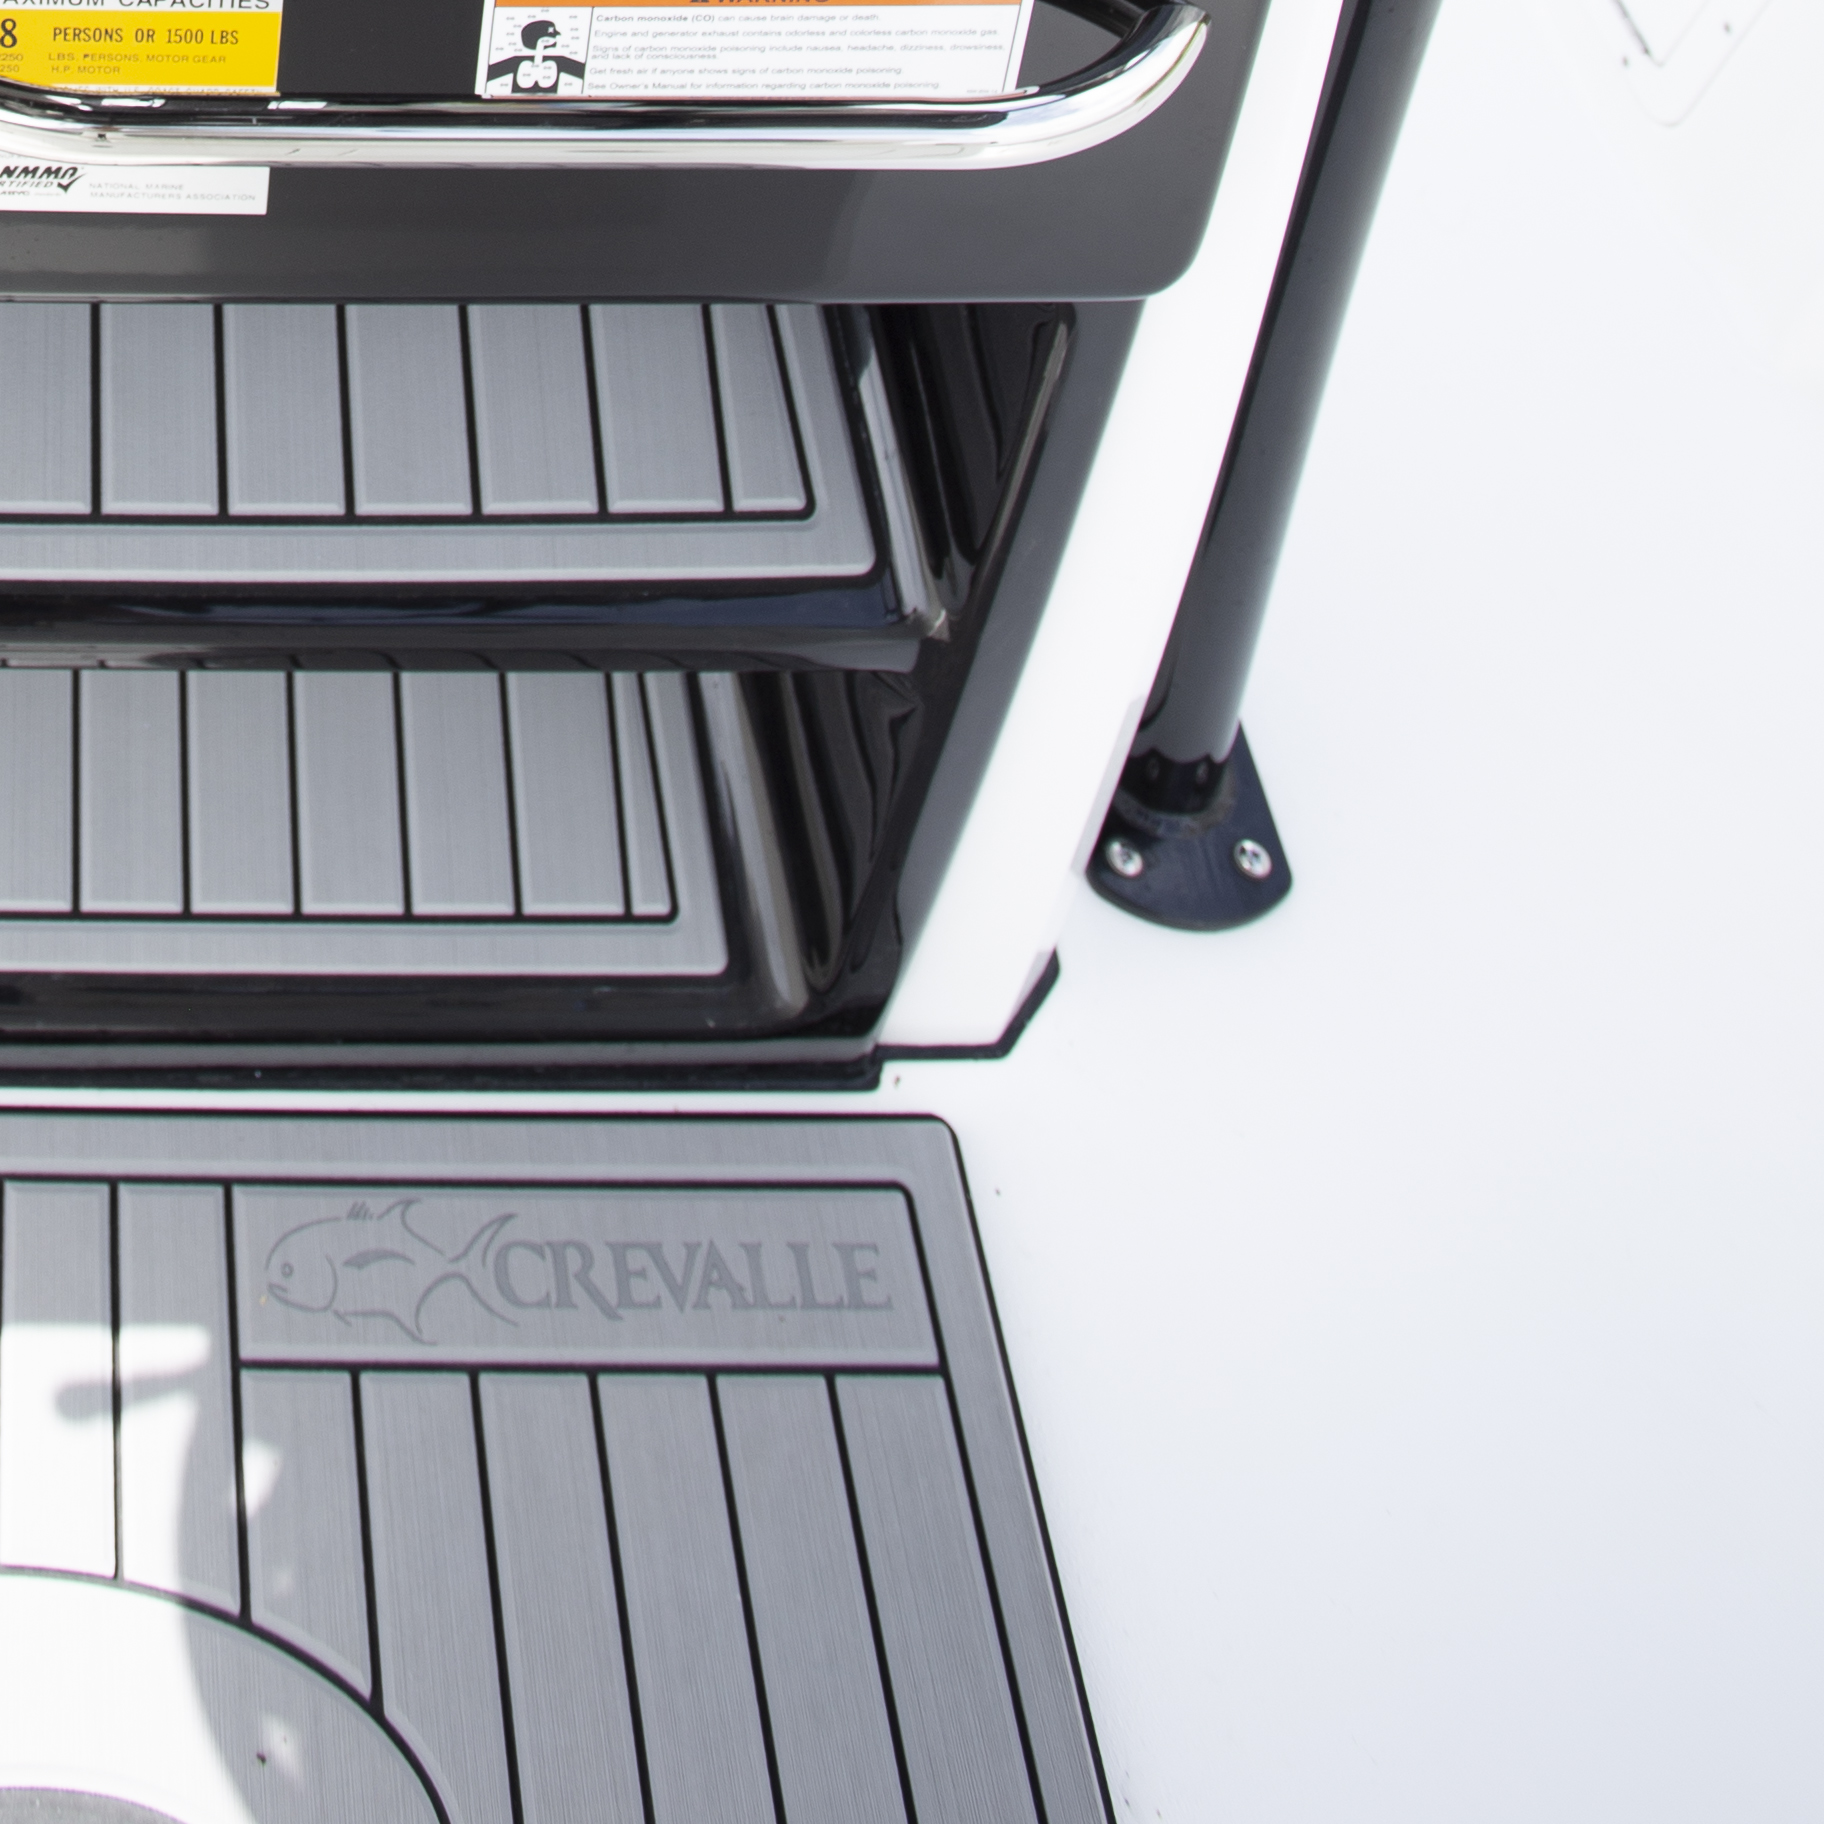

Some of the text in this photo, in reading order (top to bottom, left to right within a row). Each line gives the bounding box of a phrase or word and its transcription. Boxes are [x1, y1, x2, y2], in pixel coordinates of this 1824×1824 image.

[691, 14, 715, 23] (CO)
[797, 14, 836, 23] damage
[0, 18, 18, 48] 8
[53, 27, 239, 45] PERSONS OR 1500 LBS
[594, 30, 628, 38] Engine
[652, 30, 698, 38] generator
[592, 45, 619, 53] Signs
[720, 45, 766, 53] poisoning
[146, 54, 189, 63] MOTOR
[192, 55, 227, 63] GEAR
[0, 65, 20, 73] 250
[77, 66, 121, 74] MOTOR
[761, 82, 806, 90] regarding
[89, 182, 184, 191] NATIONAL MARINE
[90, 192, 255, 201] MANUFACTURERS ASSOCIATION
[493, 1239, 894, 1321] CREVALLE
